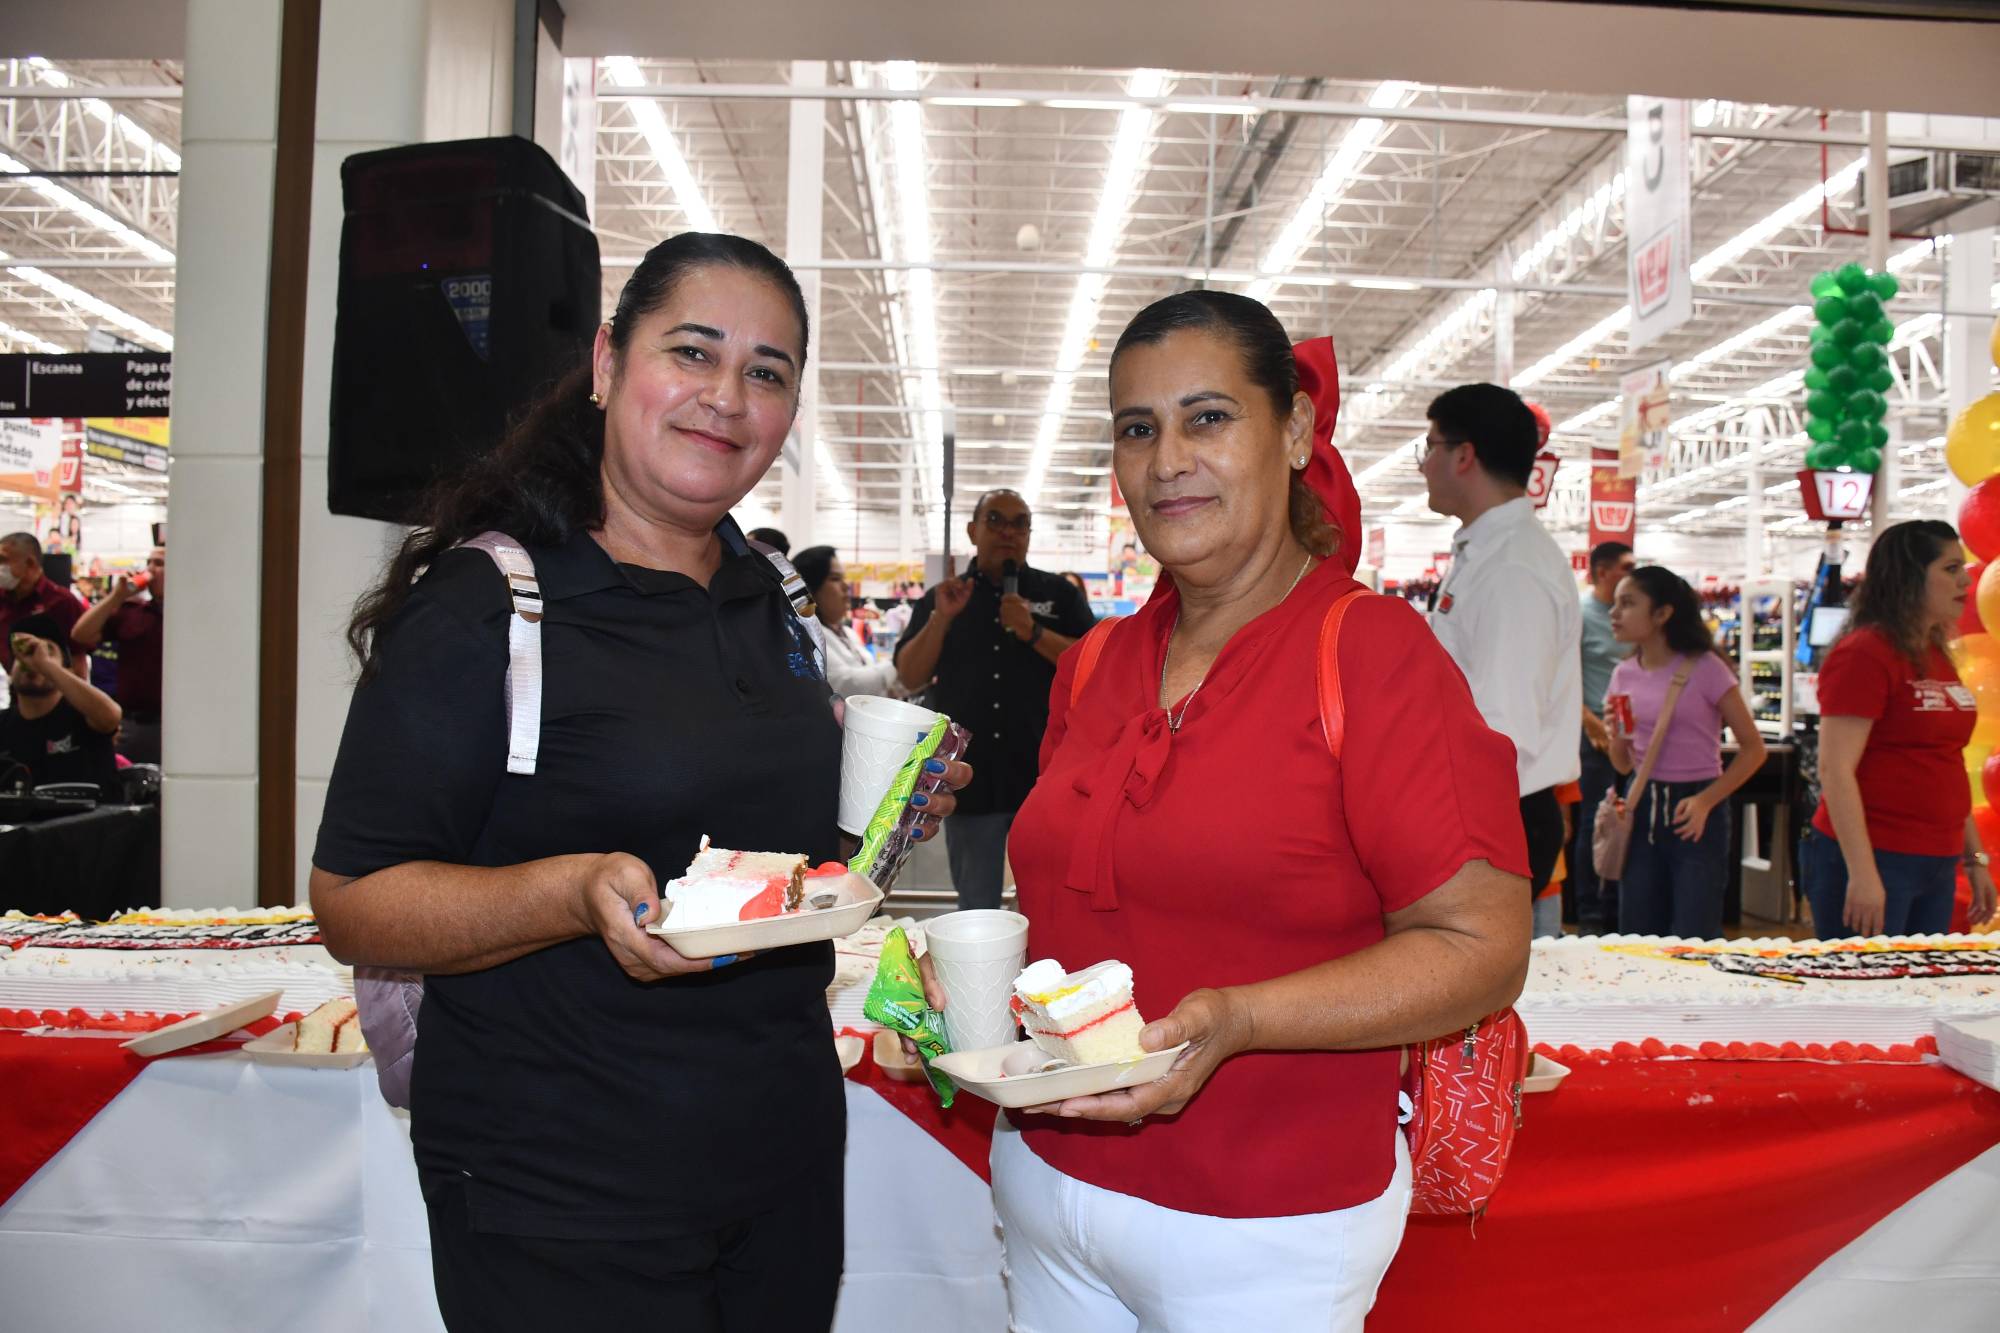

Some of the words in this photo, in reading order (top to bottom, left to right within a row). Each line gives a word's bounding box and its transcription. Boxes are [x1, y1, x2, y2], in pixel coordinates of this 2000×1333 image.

[448, 280, 492, 298] 2000
[31, 361, 84, 375] Escanea
[126, 360, 158, 376] Paga
[126, 378, 143, 392] de
[126, 397, 135, 411] y
[1824, 479, 1860, 511] 12
